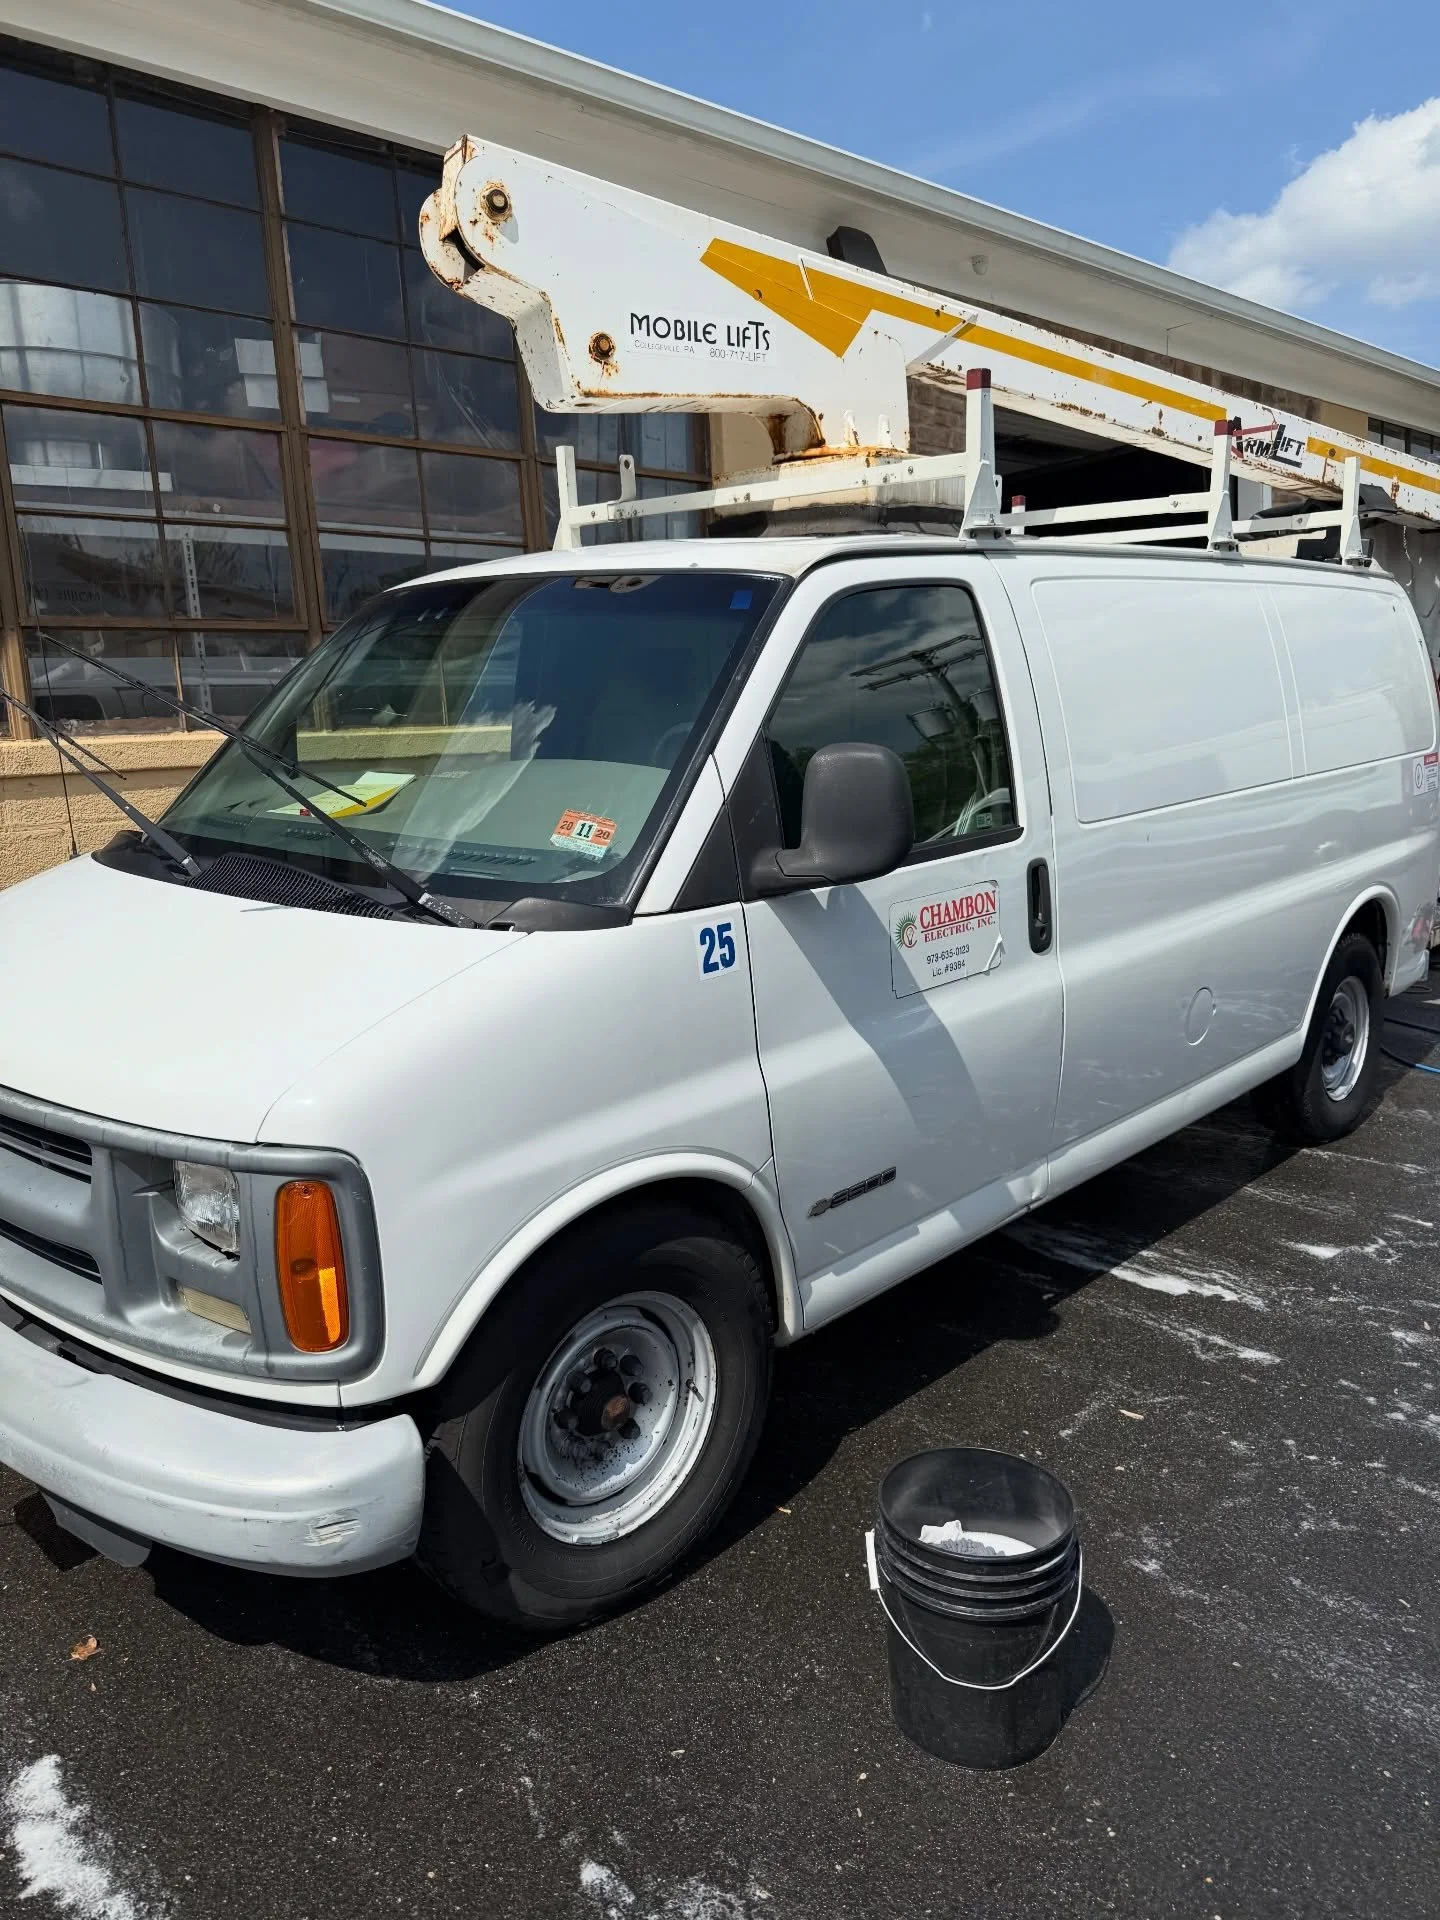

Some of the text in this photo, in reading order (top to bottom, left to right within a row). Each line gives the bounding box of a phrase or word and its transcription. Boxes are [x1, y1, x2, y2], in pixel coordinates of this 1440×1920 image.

[630, 312, 771, 351] MOBILE LIFTS
[709, 347, 767, 363] 800-717-LIFT
[560, 820, 610, 840] 20 11 20
[919, 889, 996, 930] CHAMBON
[924, 915, 996, 943] ELECTRIC, INC.
[699, 922, 736, 974] 25
[926, 944, 970, 965] 973-635-0123
